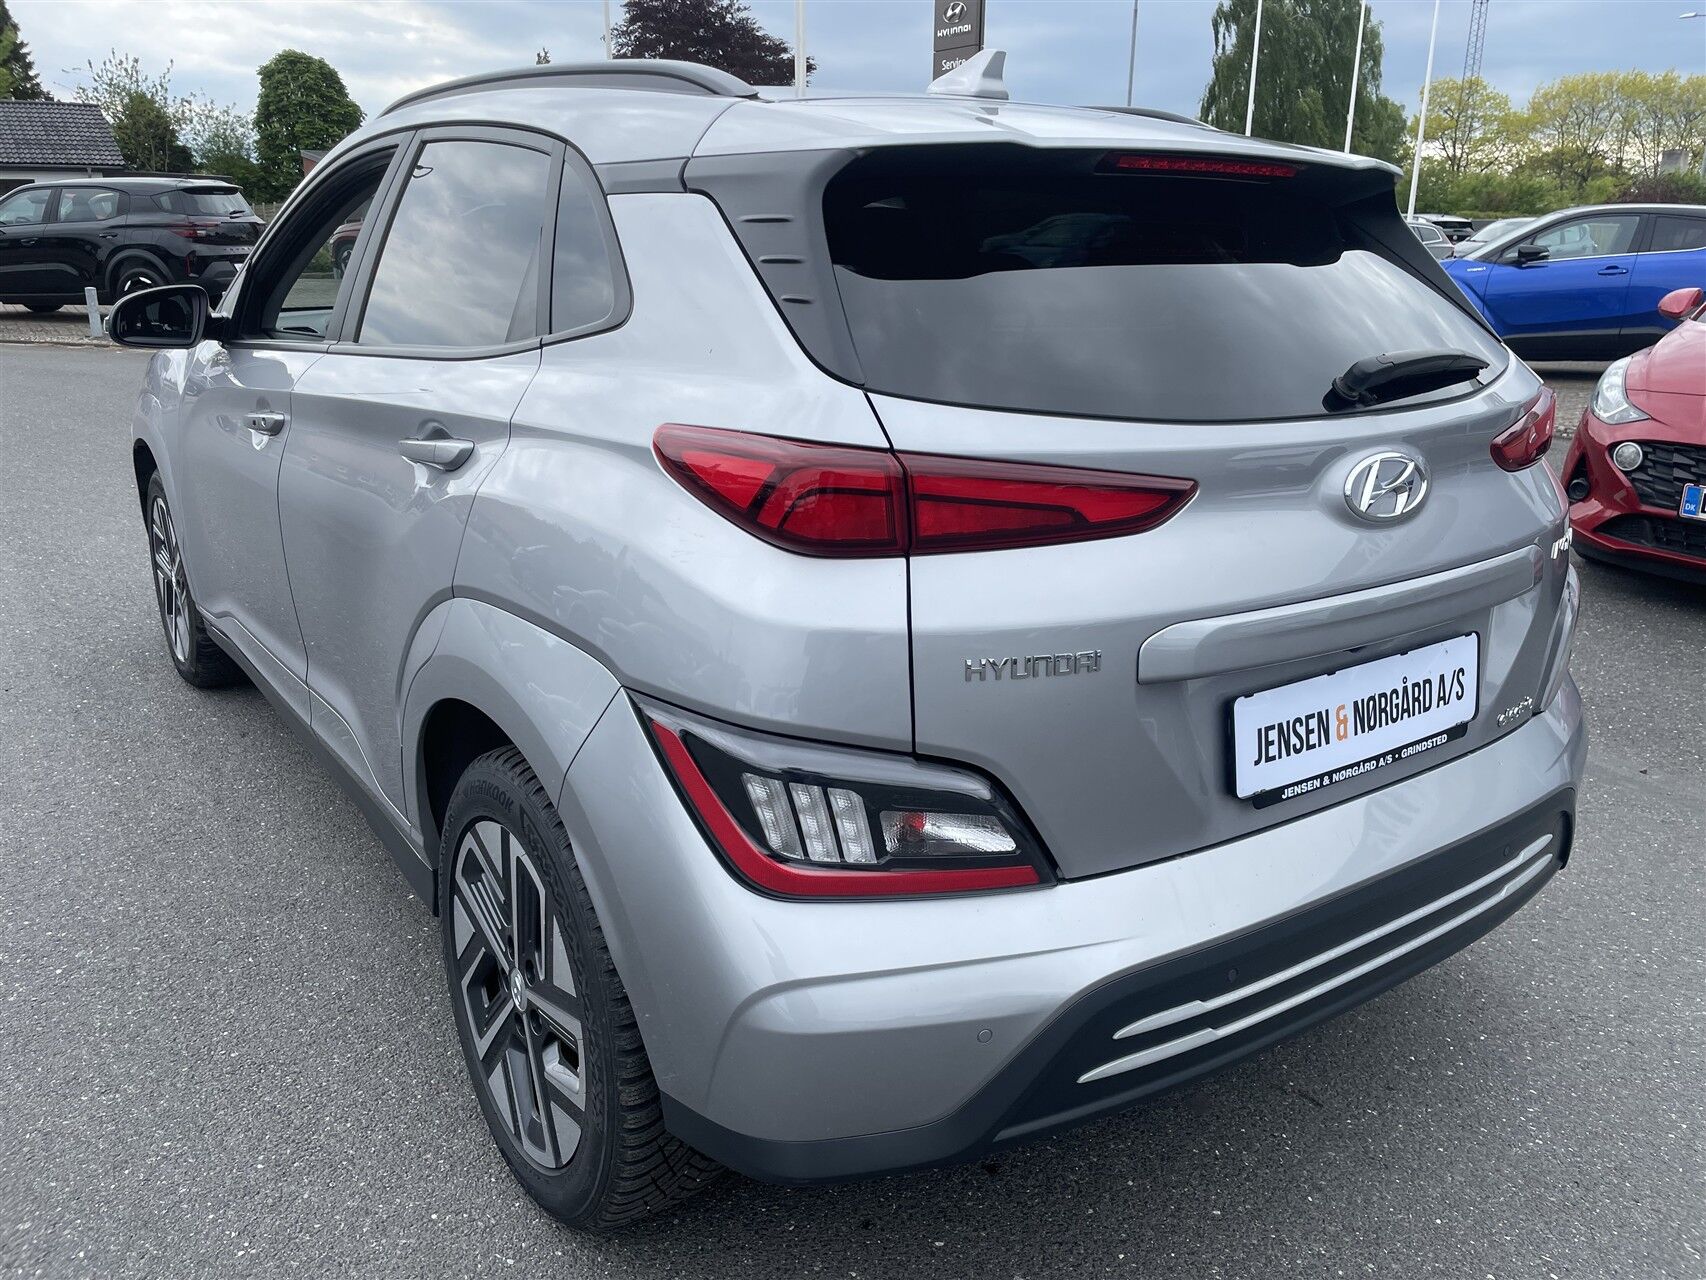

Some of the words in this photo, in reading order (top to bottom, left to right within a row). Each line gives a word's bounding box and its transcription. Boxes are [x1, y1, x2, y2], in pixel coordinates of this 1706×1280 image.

[937, 24, 972, 37] HYUNDAI
[1685, 503, 1696, 511] DK
[965, 649, 1102, 682] HYUNDAI
[1254, 709, 1330, 766] JENSEN
[1335, 704, 1348, 741] &
[1353, 676, 1433, 736] NØRGÅRD
[1436, 667, 1465, 708] A/S
[1281, 779, 1320, 799] JENSEN
[1323, 777, 1330, 786] &
[1332, 760, 1377, 782] NØRGÅRD
[1378, 756, 1393, 767] A/S
[1401, 734, 1448, 759] GRINDSTED
